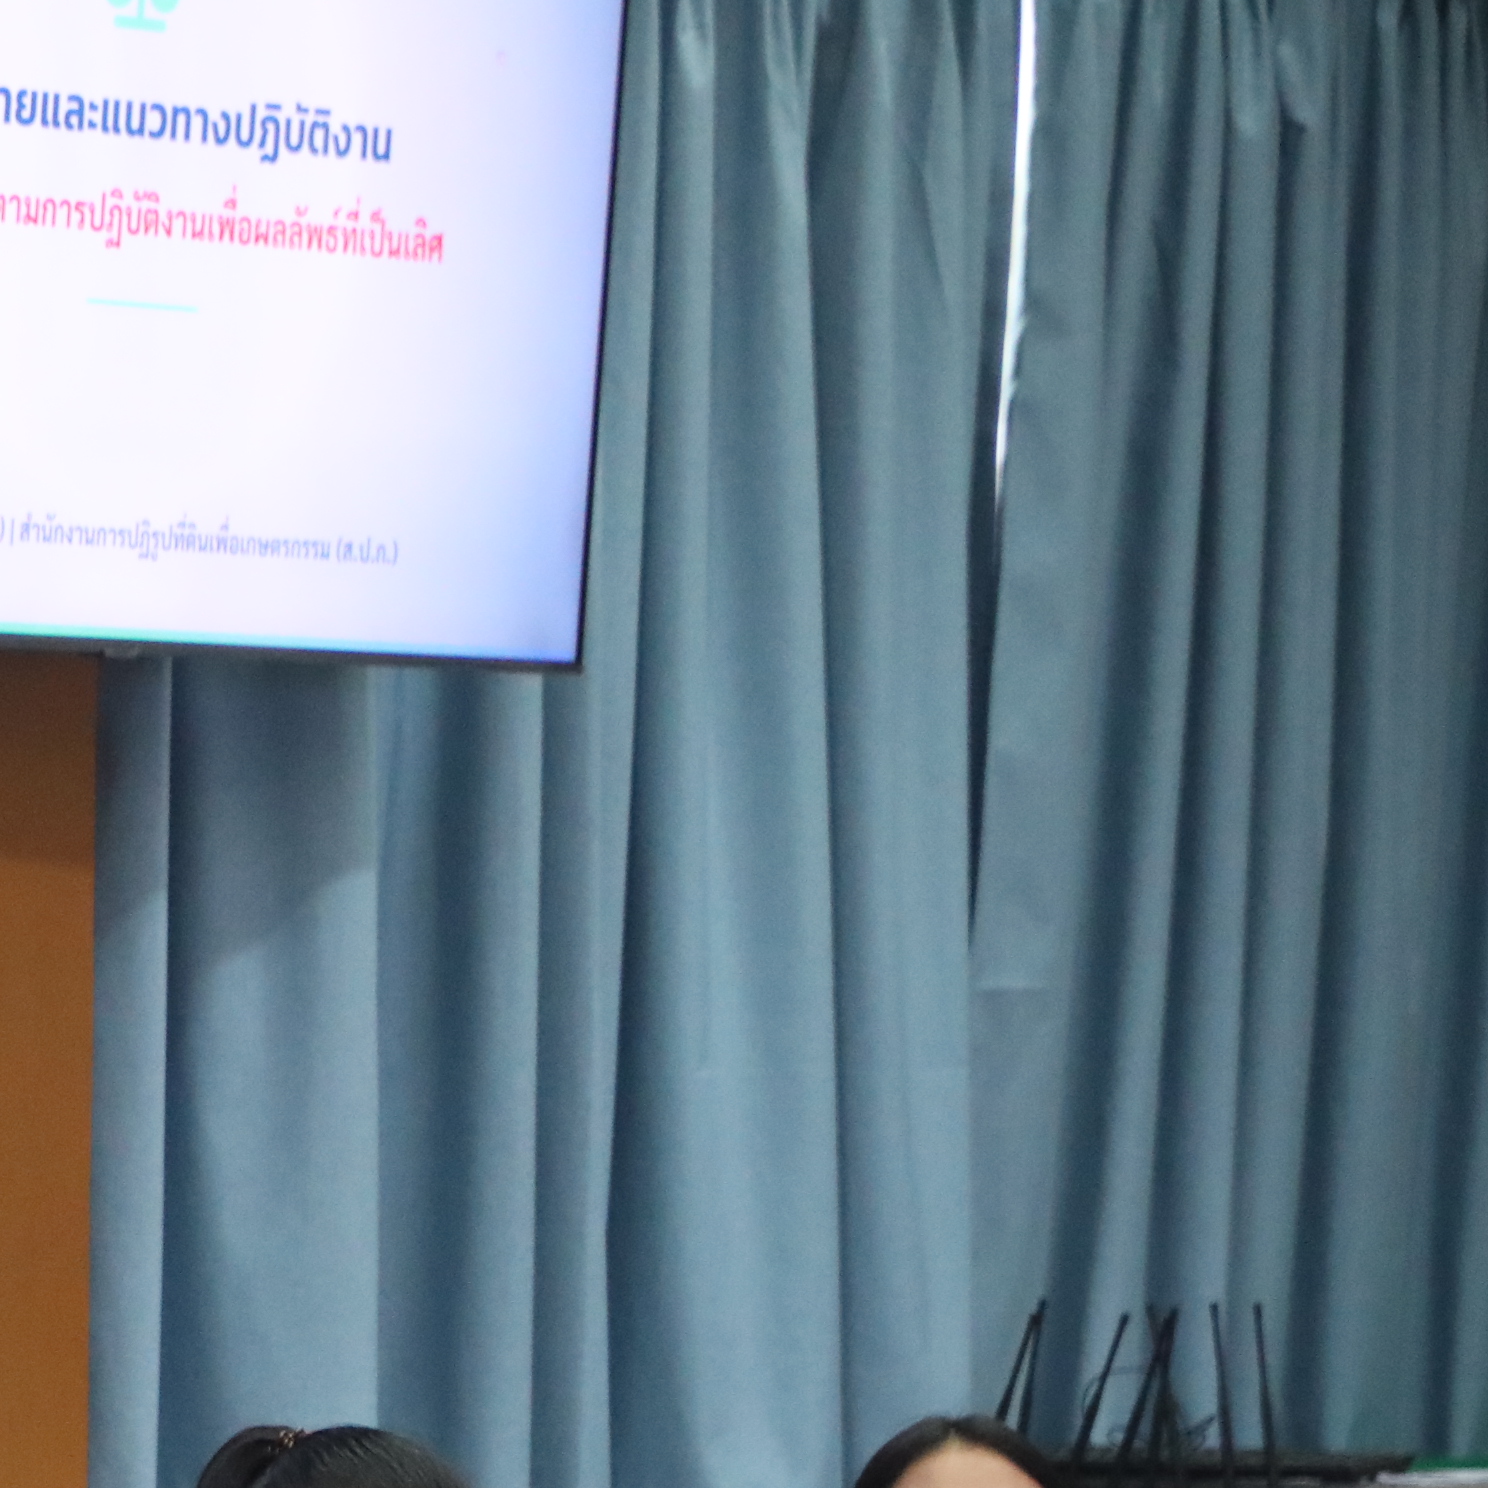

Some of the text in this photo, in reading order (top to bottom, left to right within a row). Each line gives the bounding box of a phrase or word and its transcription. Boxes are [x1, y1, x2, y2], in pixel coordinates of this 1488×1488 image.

[19, 512, 331, 562] สำนักงานการปฏิรูปที่ดินเพื่อเกษตรกรรม
[336, 537, 400, 566] (ส.ป.ก.)
